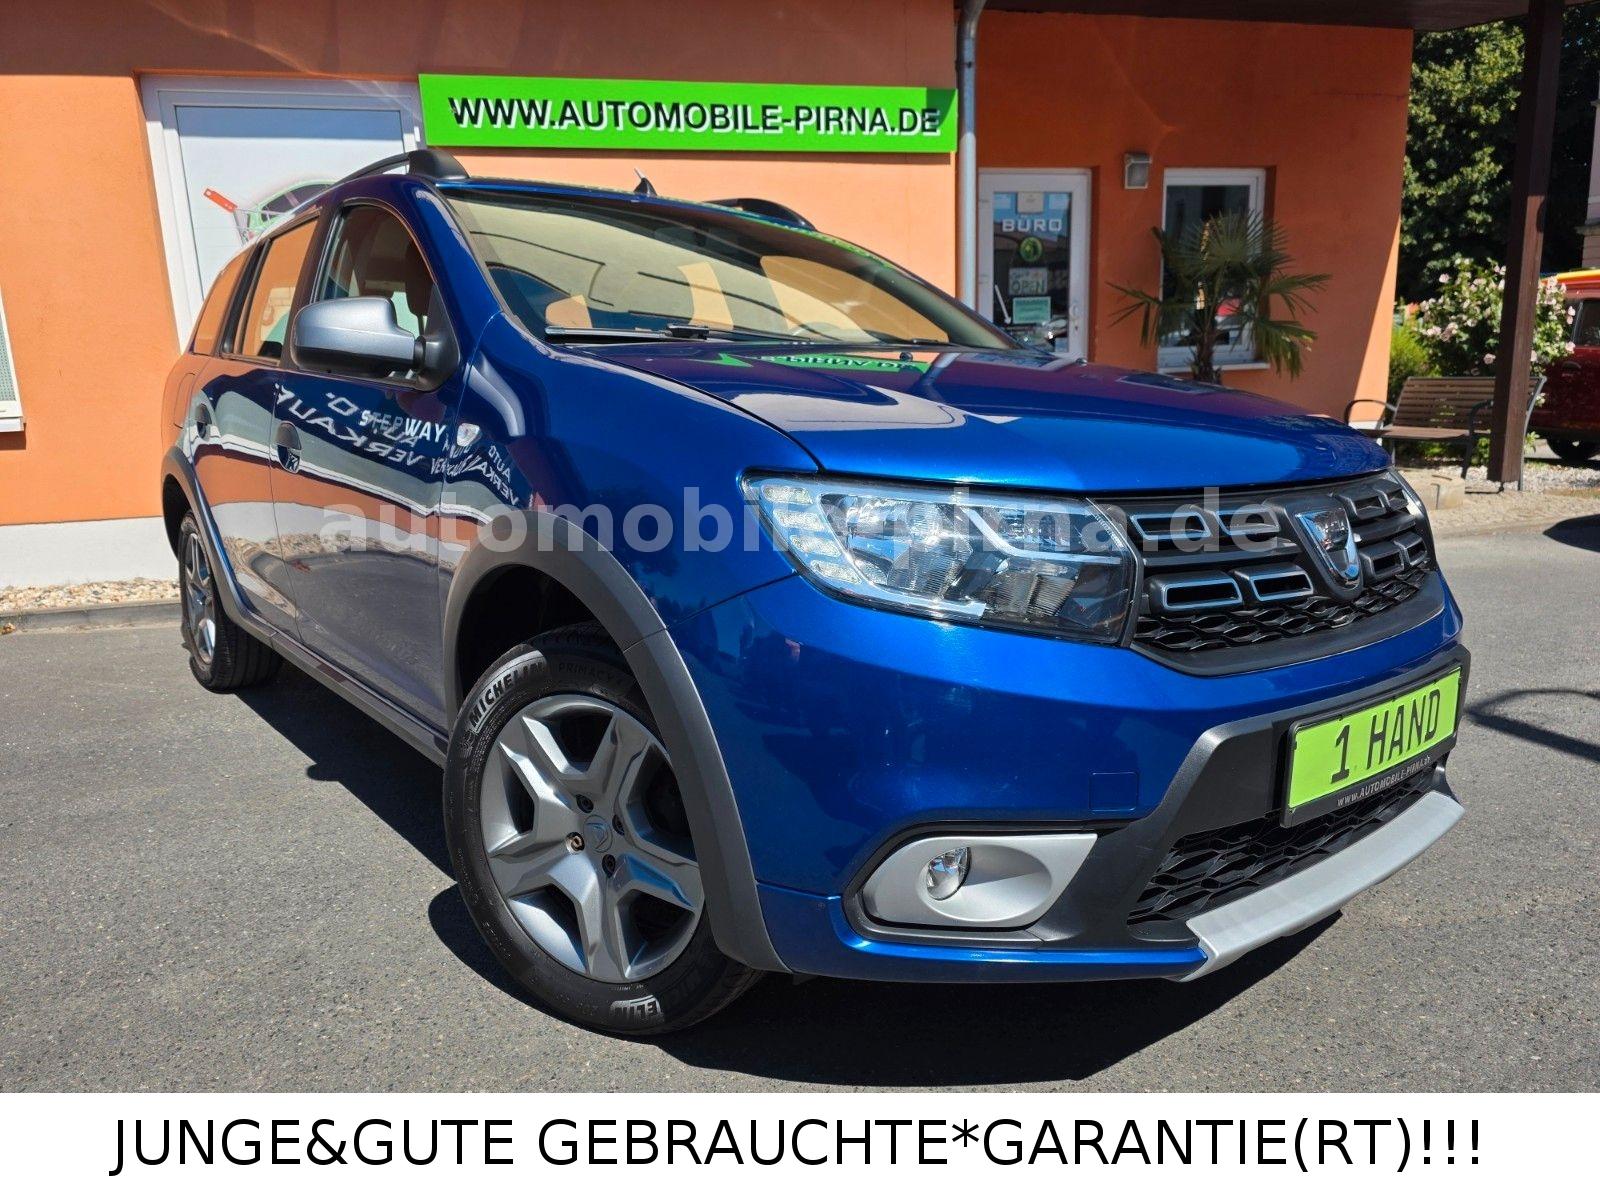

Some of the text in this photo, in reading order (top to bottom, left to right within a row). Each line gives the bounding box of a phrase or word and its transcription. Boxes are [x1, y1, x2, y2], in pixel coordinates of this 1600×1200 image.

[447, 97, 942, 137] WWW.AUTOMOBILE-PIRNA.DE
[1002, 215, 1062, 232] BÜRO
[468, 660, 547, 729] MICHELIN
[1331, 688, 1441, 785] 1 HAND
